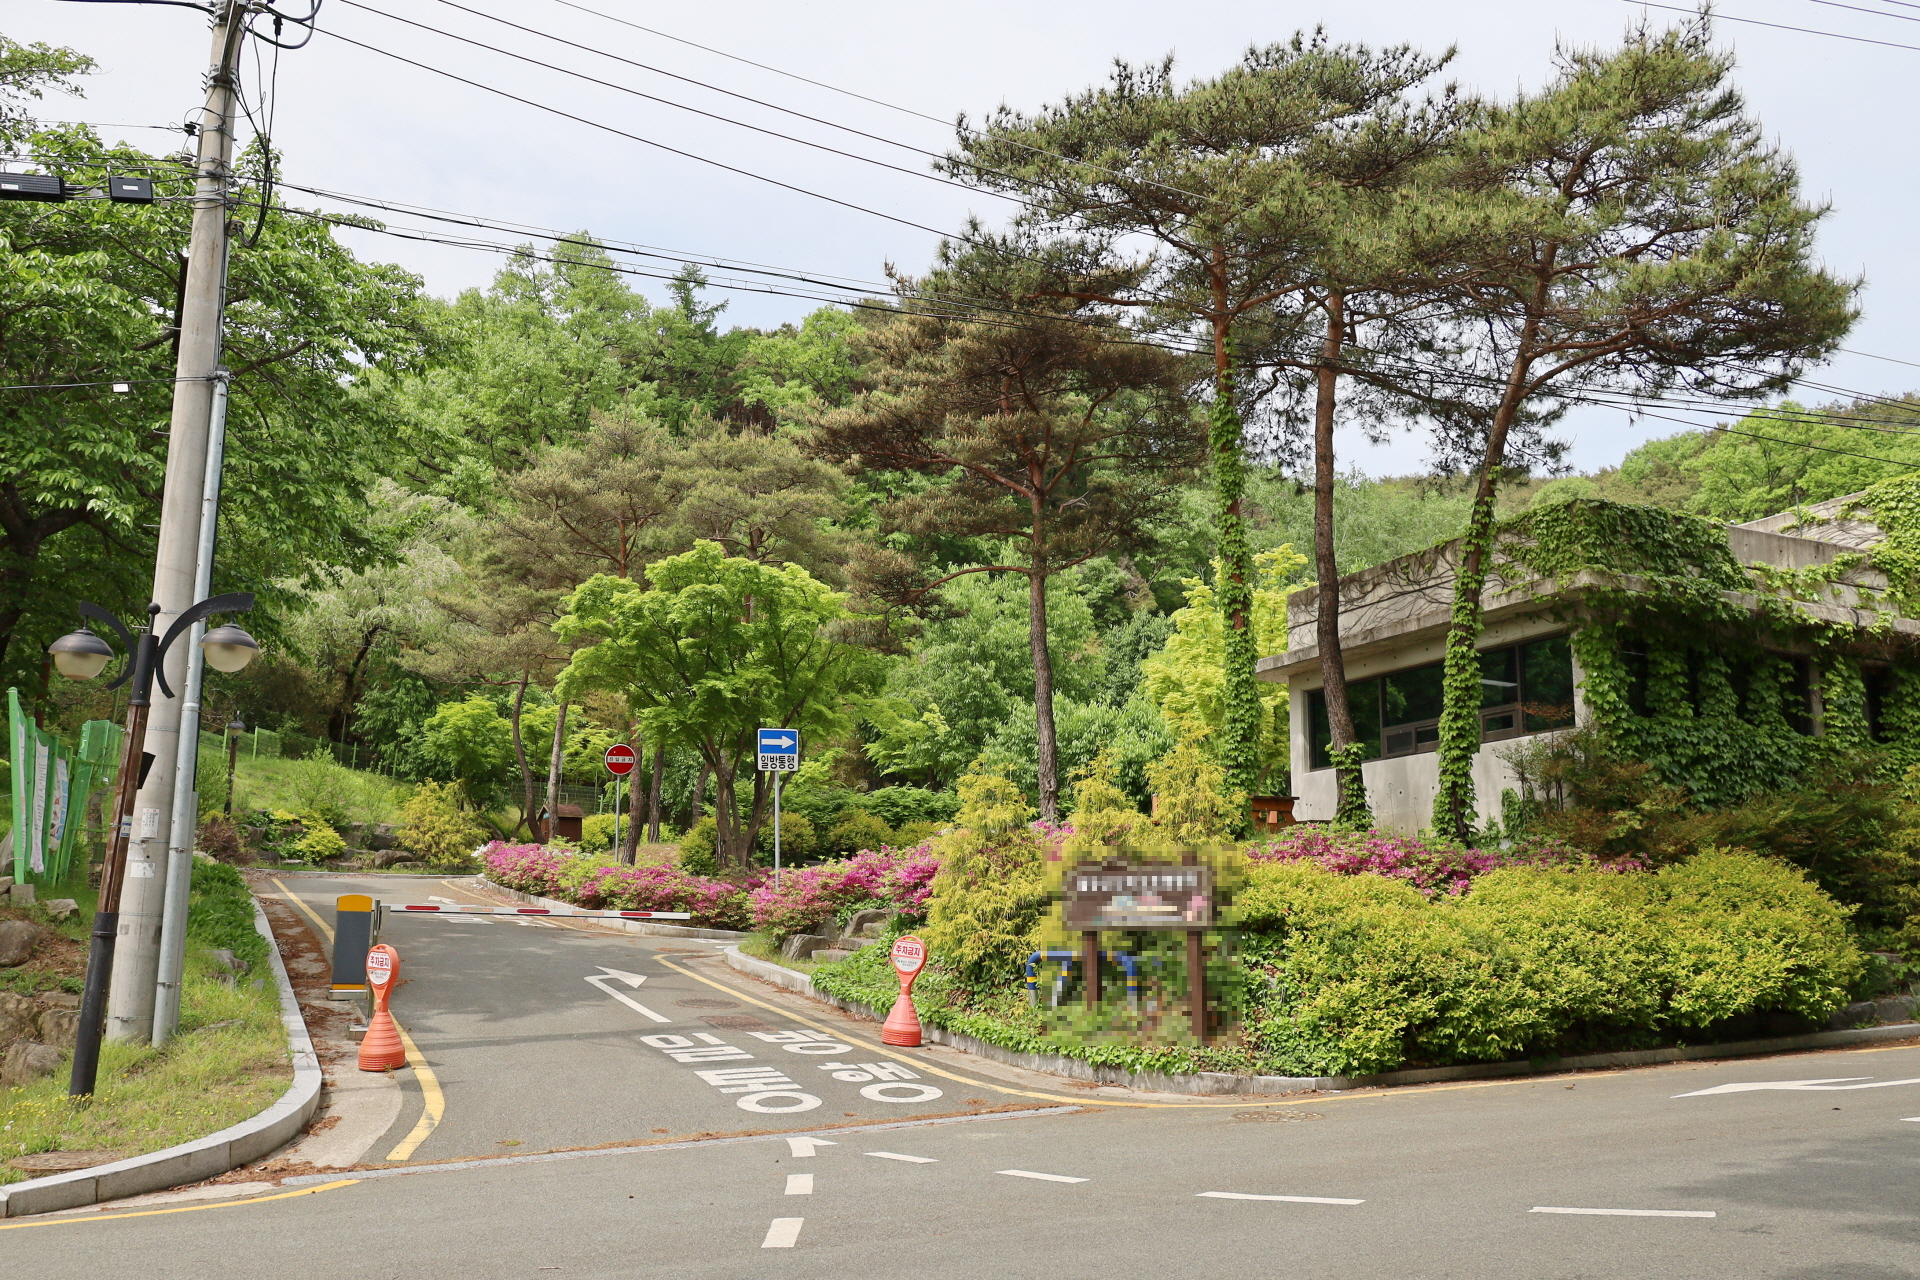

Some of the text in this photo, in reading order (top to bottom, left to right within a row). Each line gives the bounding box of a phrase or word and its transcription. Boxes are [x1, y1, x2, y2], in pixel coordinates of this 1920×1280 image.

[760, 754, 795, 770] 일방통행
[896, 944, 921, 957] 주차금지
[370, 955, 389, 968] 주차금지
